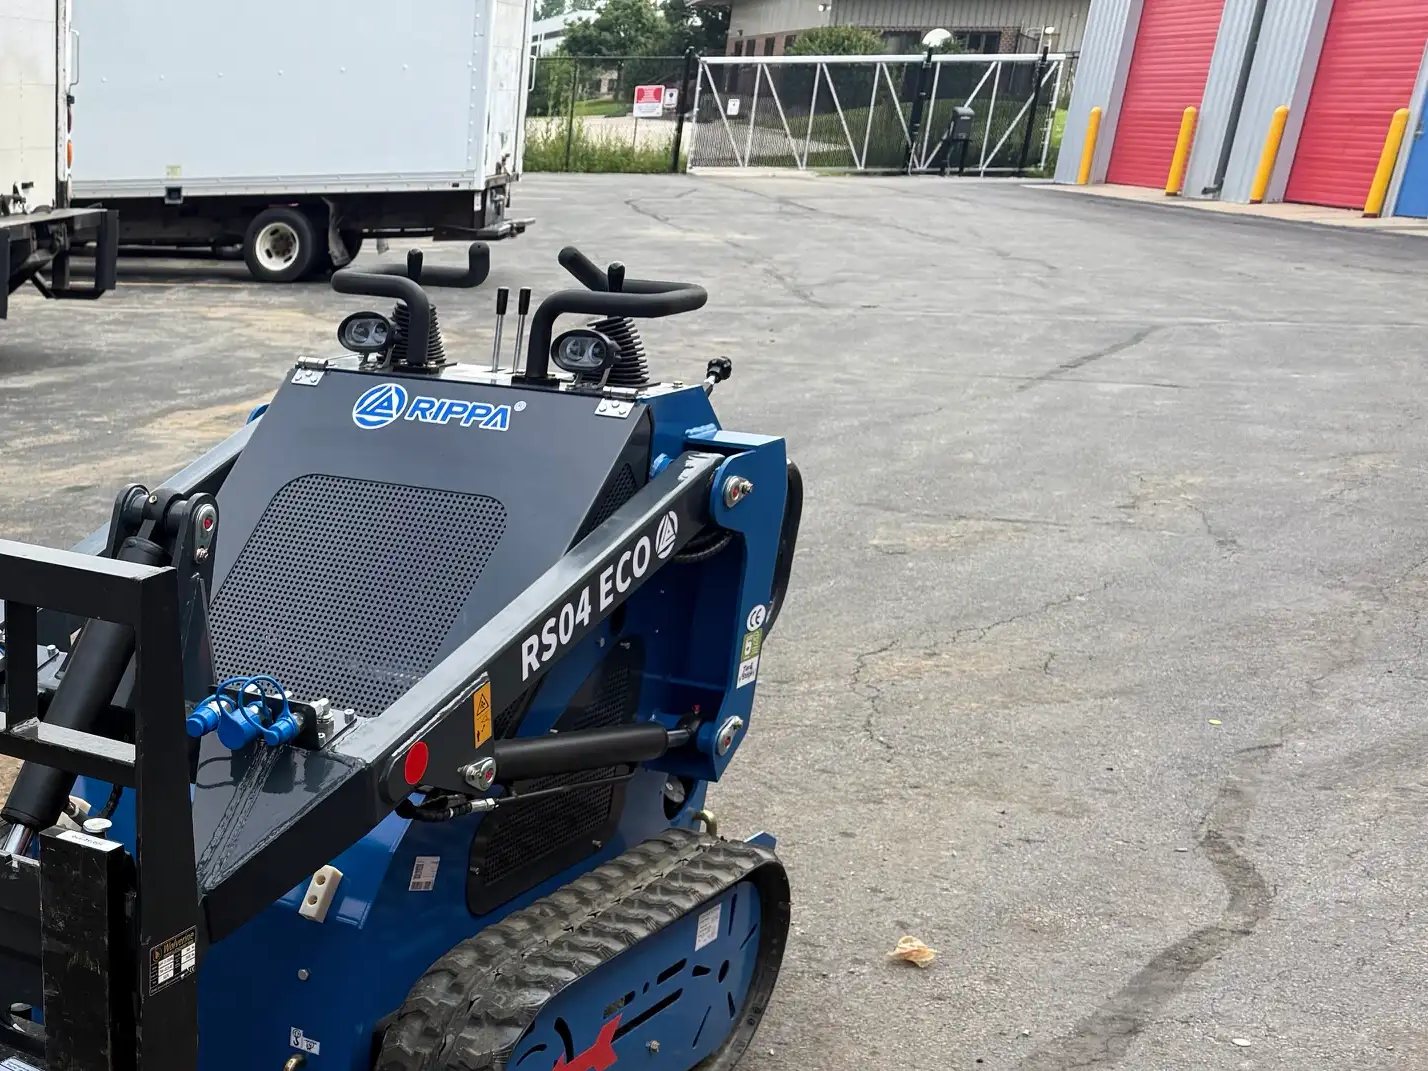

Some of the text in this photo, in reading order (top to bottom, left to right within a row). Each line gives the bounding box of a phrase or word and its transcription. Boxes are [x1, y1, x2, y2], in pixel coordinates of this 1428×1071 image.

[404, 396, 512, 431] RIPPA
[521, 535, 651, 682] RS04 ECO
